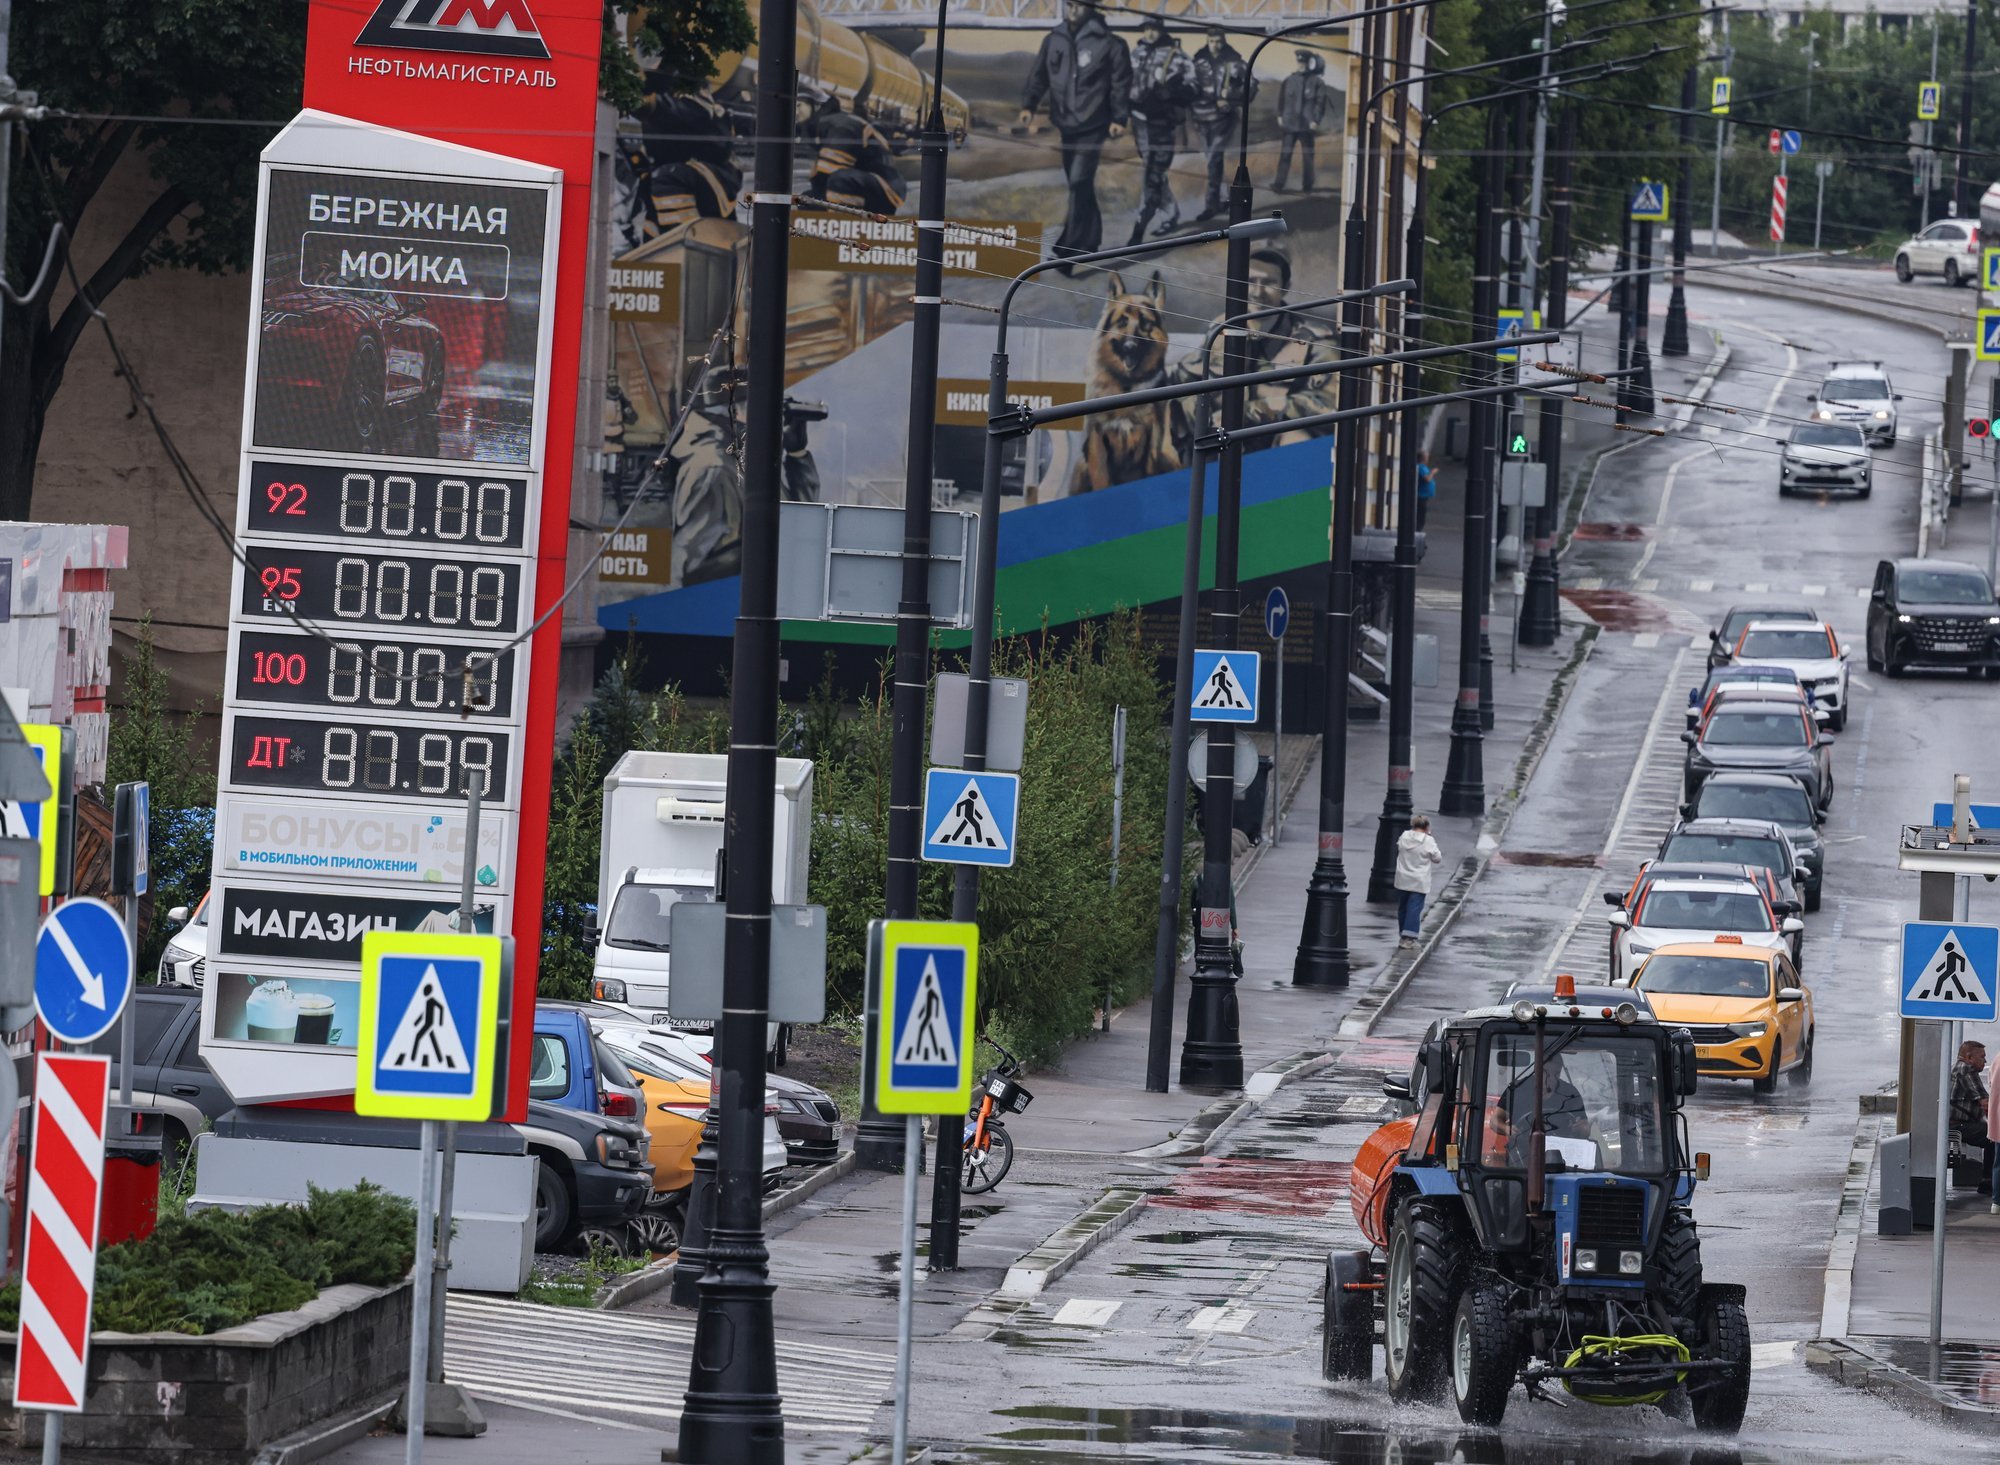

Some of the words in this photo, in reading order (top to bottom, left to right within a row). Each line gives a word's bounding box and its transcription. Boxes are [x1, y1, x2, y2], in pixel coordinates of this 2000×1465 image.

[348, 56, 558, 88] НЕФТЬМАГИСТРАЛЬ
[308, 193, 509, 235] БЕРЕЖНАЯ
[793, 216, 916, 243] ОБЕСПЕЧЕНИЕ
[943, 224, 1018, 248] ЖАРНОЙ
[339, 246, 469, 286] МОЙКА
[838, 244, 977, 270] БЕЗОПАССТИ
[946, 392, 1053, 413] КИНООГИЯ
[266, 482, 309, 516] 92
[339, 472, 512, 544] 00.00
[598, 556, 649, 577] ОСТЬ
[260, 567, 302, 600] 95
[333, 557, 505, 628] 00.00
[252, 651, 307, 686] 100
[247, 736, 292, 769] ДТ
[239, 811, 421, 855] БОНУСЫ
[239, 849, 248, 862] В
[250, 850, 329, 867] МОБИЛЬНОМ
[330, 855, 418, 873] ПРИЛОЖЕНИИ
[233, 906, 397, 942] МАГАЗИН
